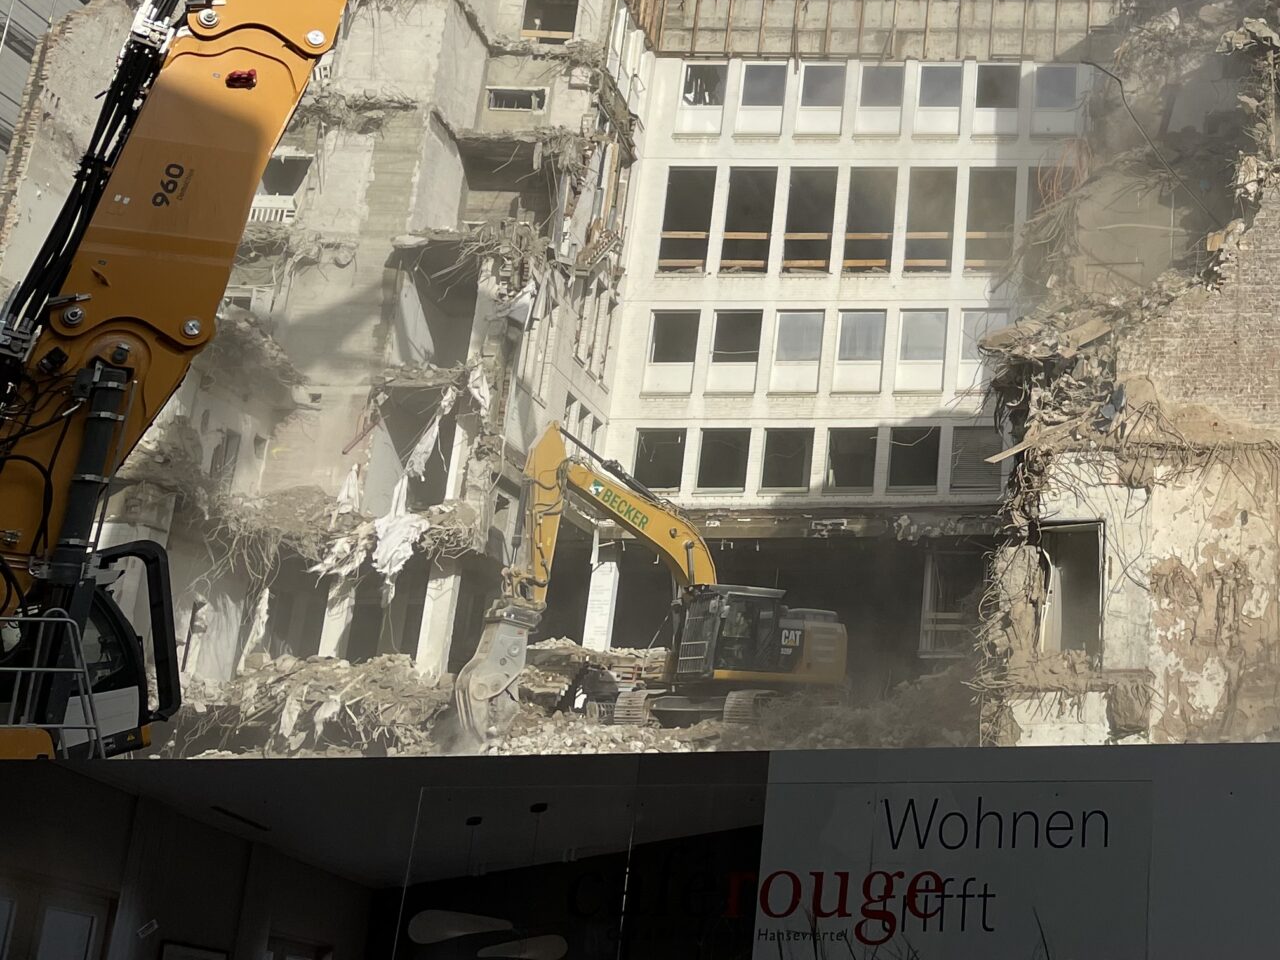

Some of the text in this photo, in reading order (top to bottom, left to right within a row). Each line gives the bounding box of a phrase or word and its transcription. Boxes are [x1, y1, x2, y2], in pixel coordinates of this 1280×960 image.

[152, 163, 184, 207] 960
[601, 488, 649, 530] BECKER
[781, 629, 802, 646] CAT
[884, 796, 1109, 850] Wohnen
